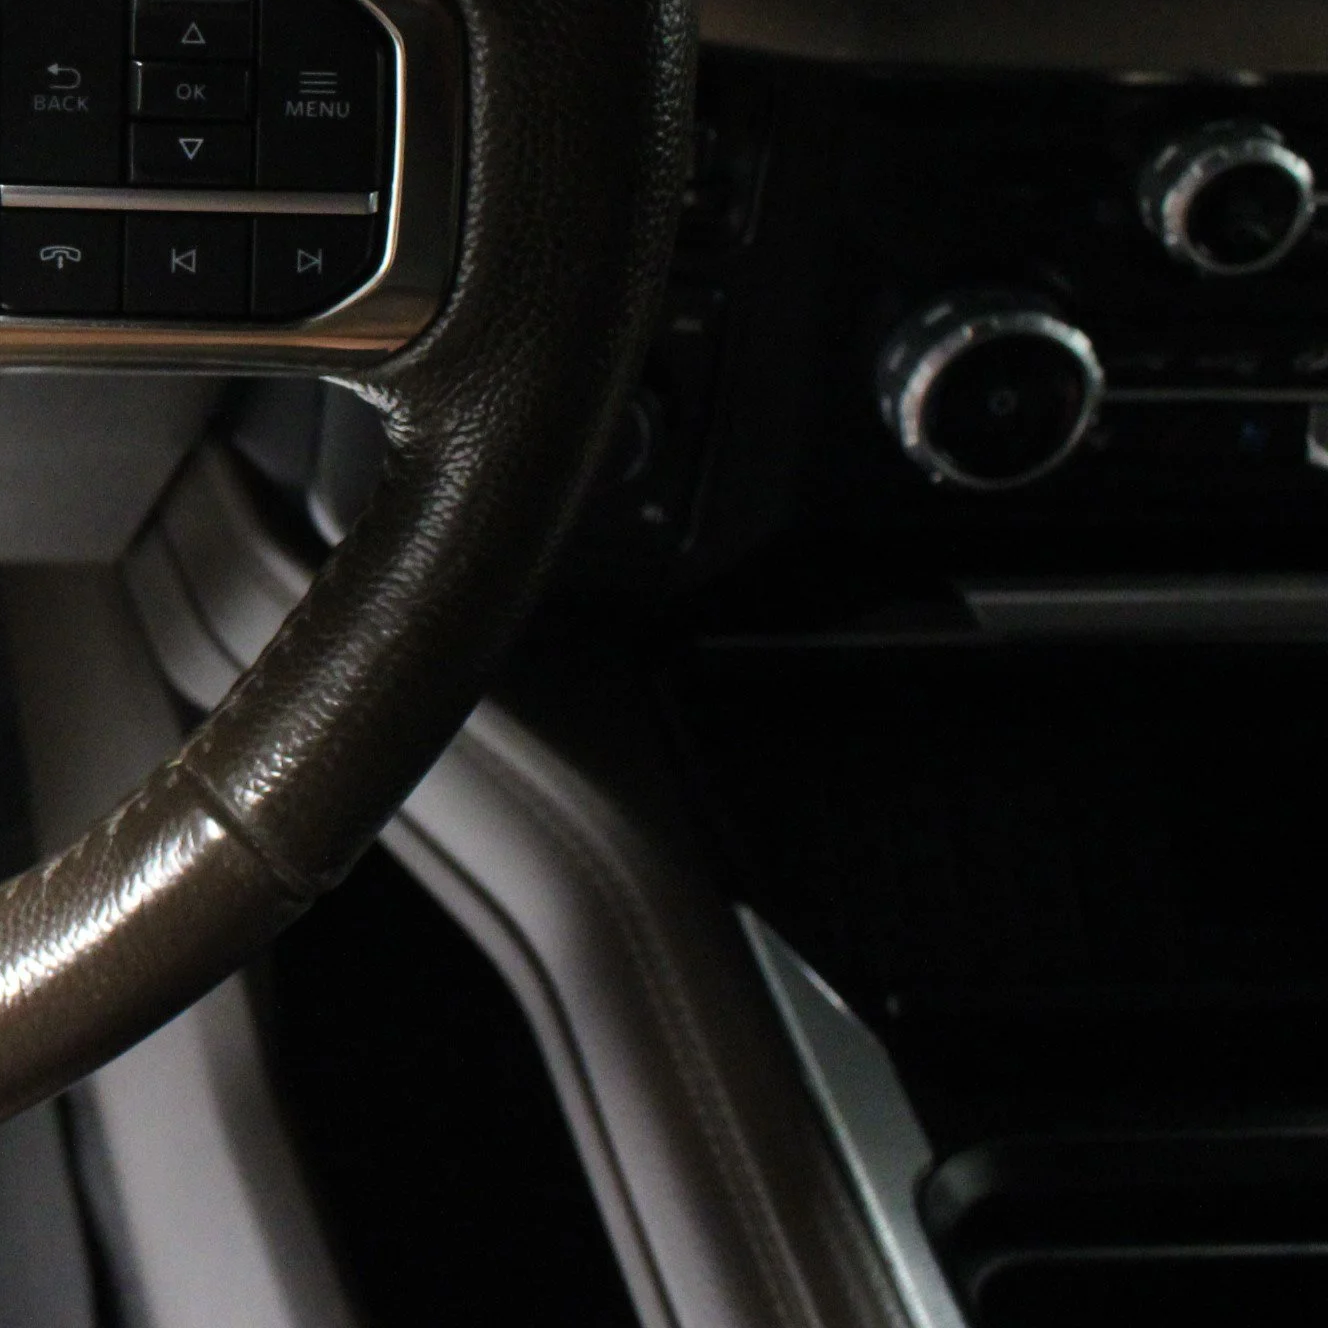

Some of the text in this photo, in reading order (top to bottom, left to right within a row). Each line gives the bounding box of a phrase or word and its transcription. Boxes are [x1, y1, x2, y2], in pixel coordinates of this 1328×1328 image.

[175, 83, 206, 101] OK
[33, 94, 89, 112] BACK
[284, 100, 351, 119] MENU
